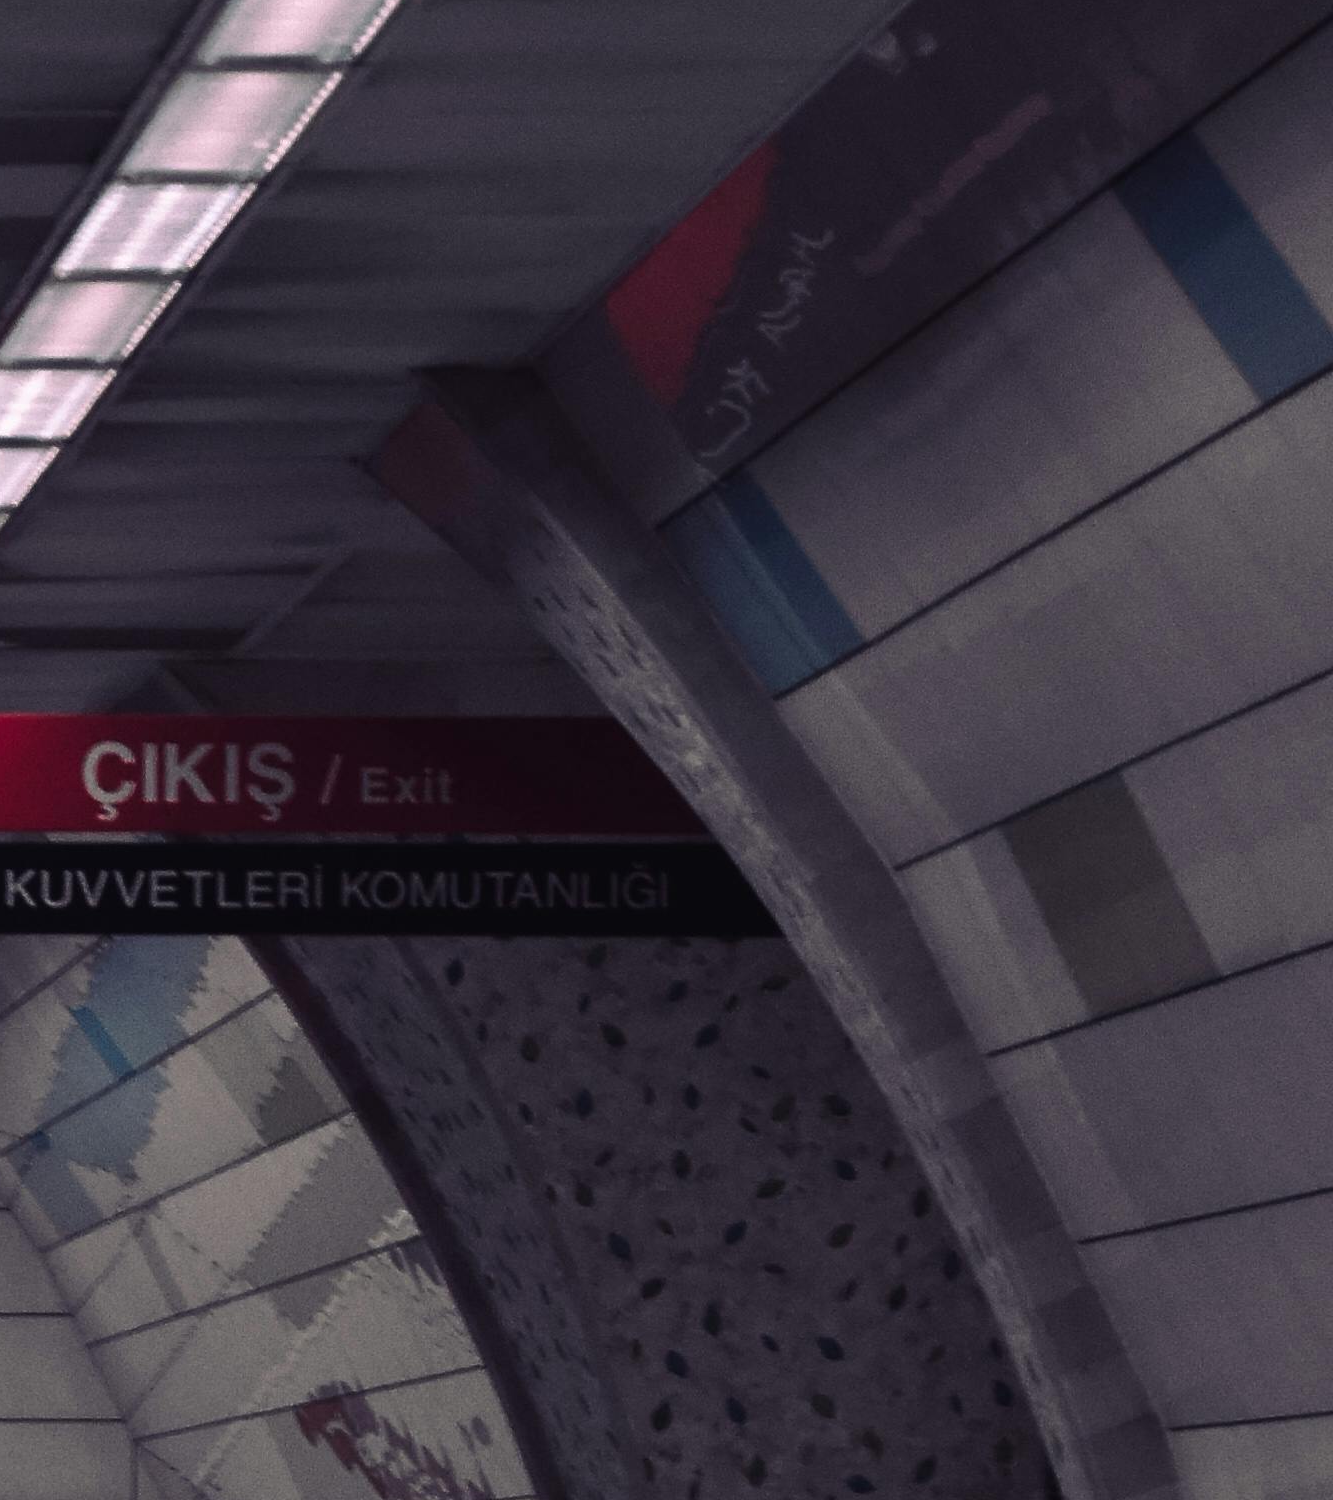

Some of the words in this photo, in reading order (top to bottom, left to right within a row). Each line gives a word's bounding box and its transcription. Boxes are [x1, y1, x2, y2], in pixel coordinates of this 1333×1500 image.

[80, 739, 299, 820] ÇIKIŞ
[359, 764, 456, 805] Exit
[3, 861, 324, 908] KUVVETLERİ
[340, 858, 669, 909] KOMUTANLIĞI
